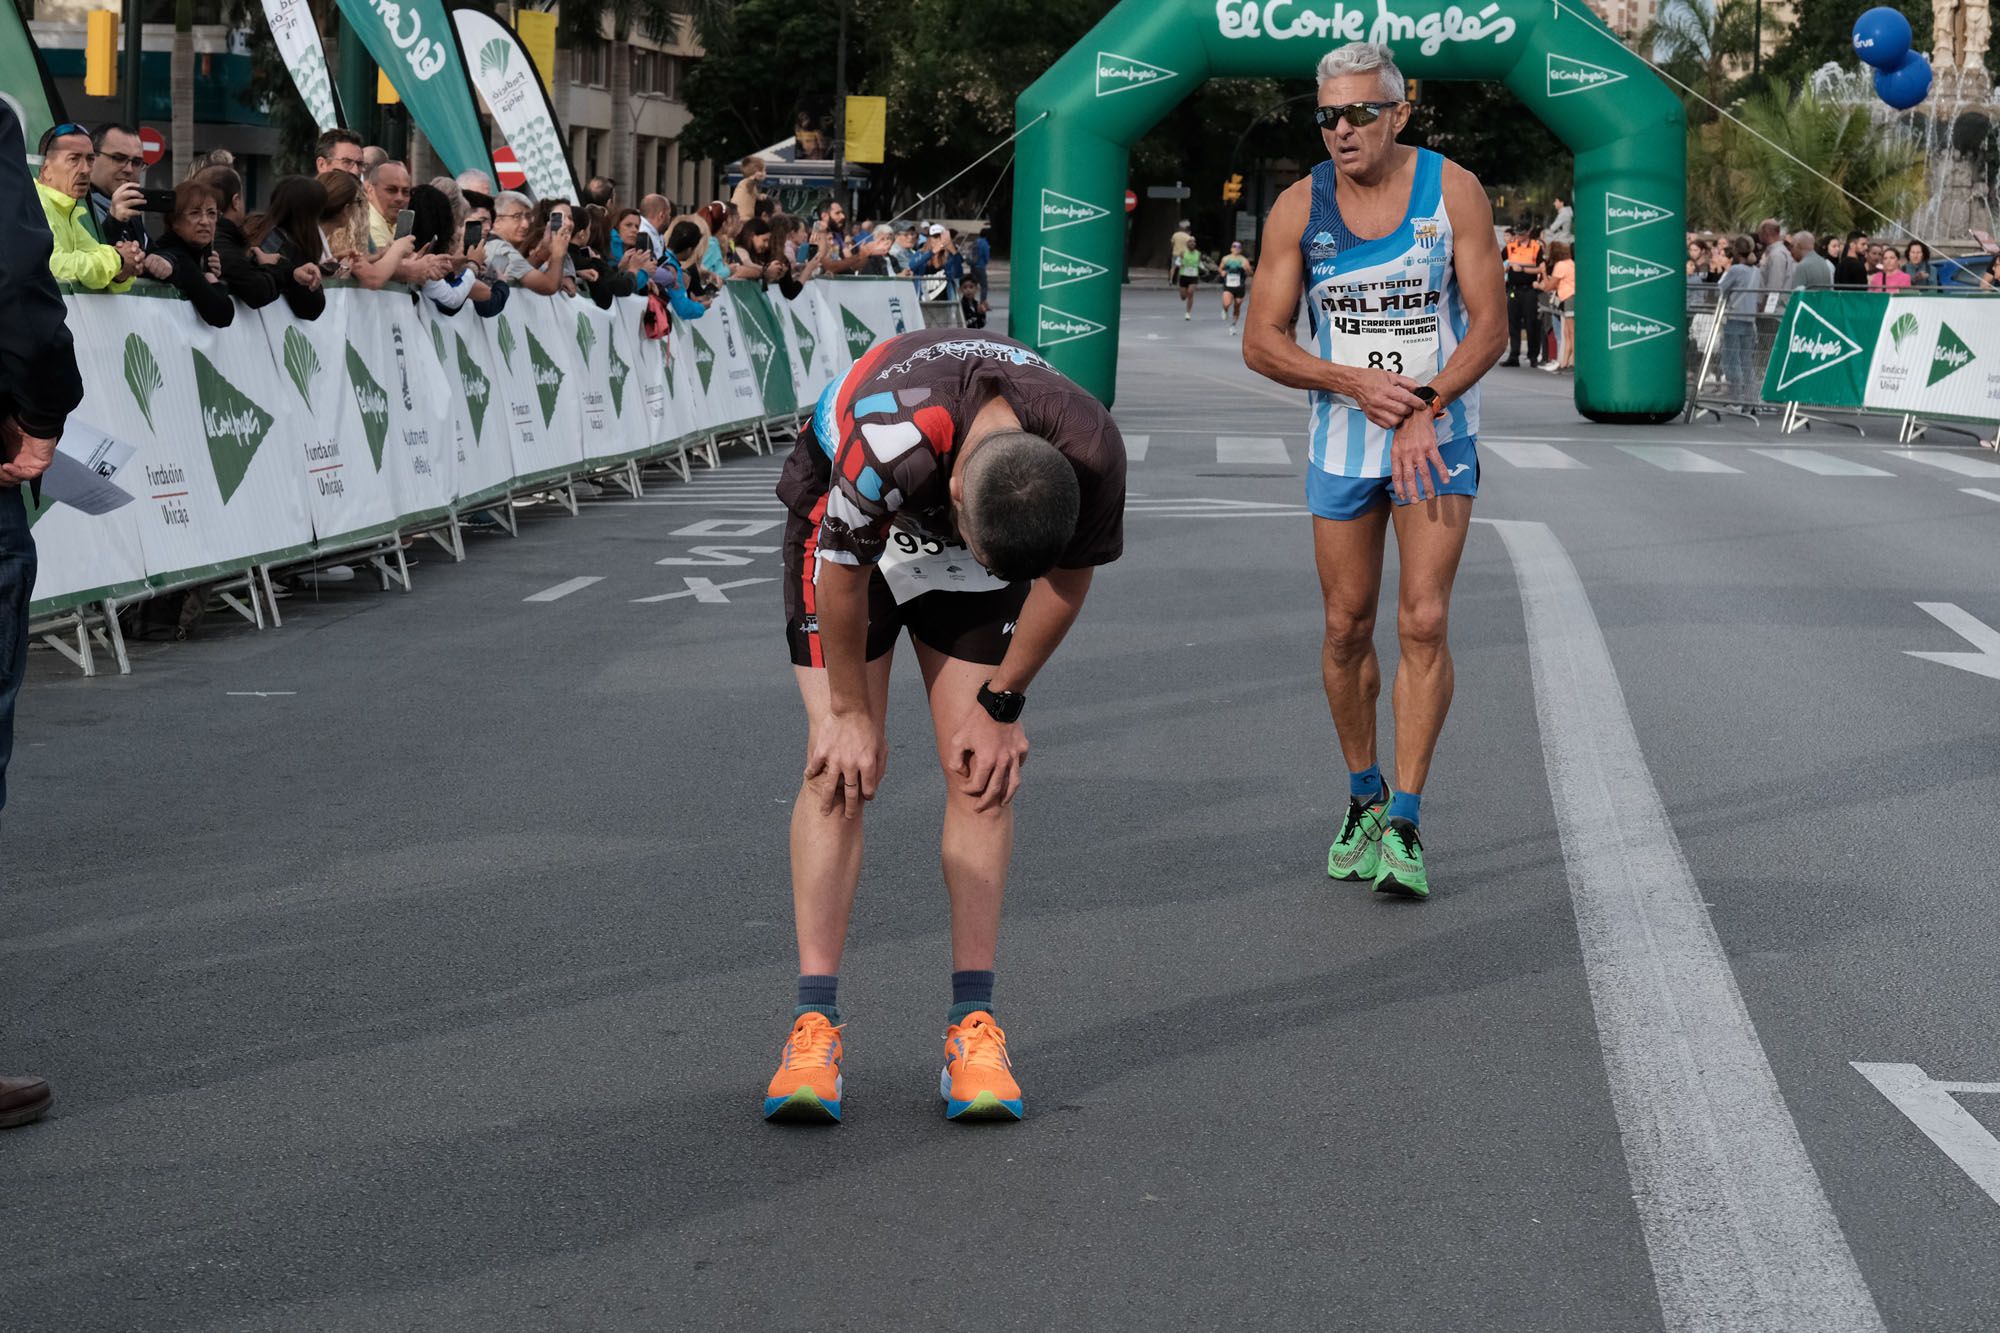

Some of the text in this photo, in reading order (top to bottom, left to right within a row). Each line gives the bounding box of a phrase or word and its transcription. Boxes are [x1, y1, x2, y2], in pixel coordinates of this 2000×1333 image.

[1216, 0, 1516, 56] El Corte Inglés
[1327, 278, 1423, 294] ATLETISMO
[1321, 290, 1441, 313] MÁLAGA
[1334, 315, 1437, 335] 43 CARRERA URBANA
[1394, 323, 1437, 336] MALAGA
[1402, 337, 1433, 345] FEDERADO
[1368, 351, 1404, 375] 83
